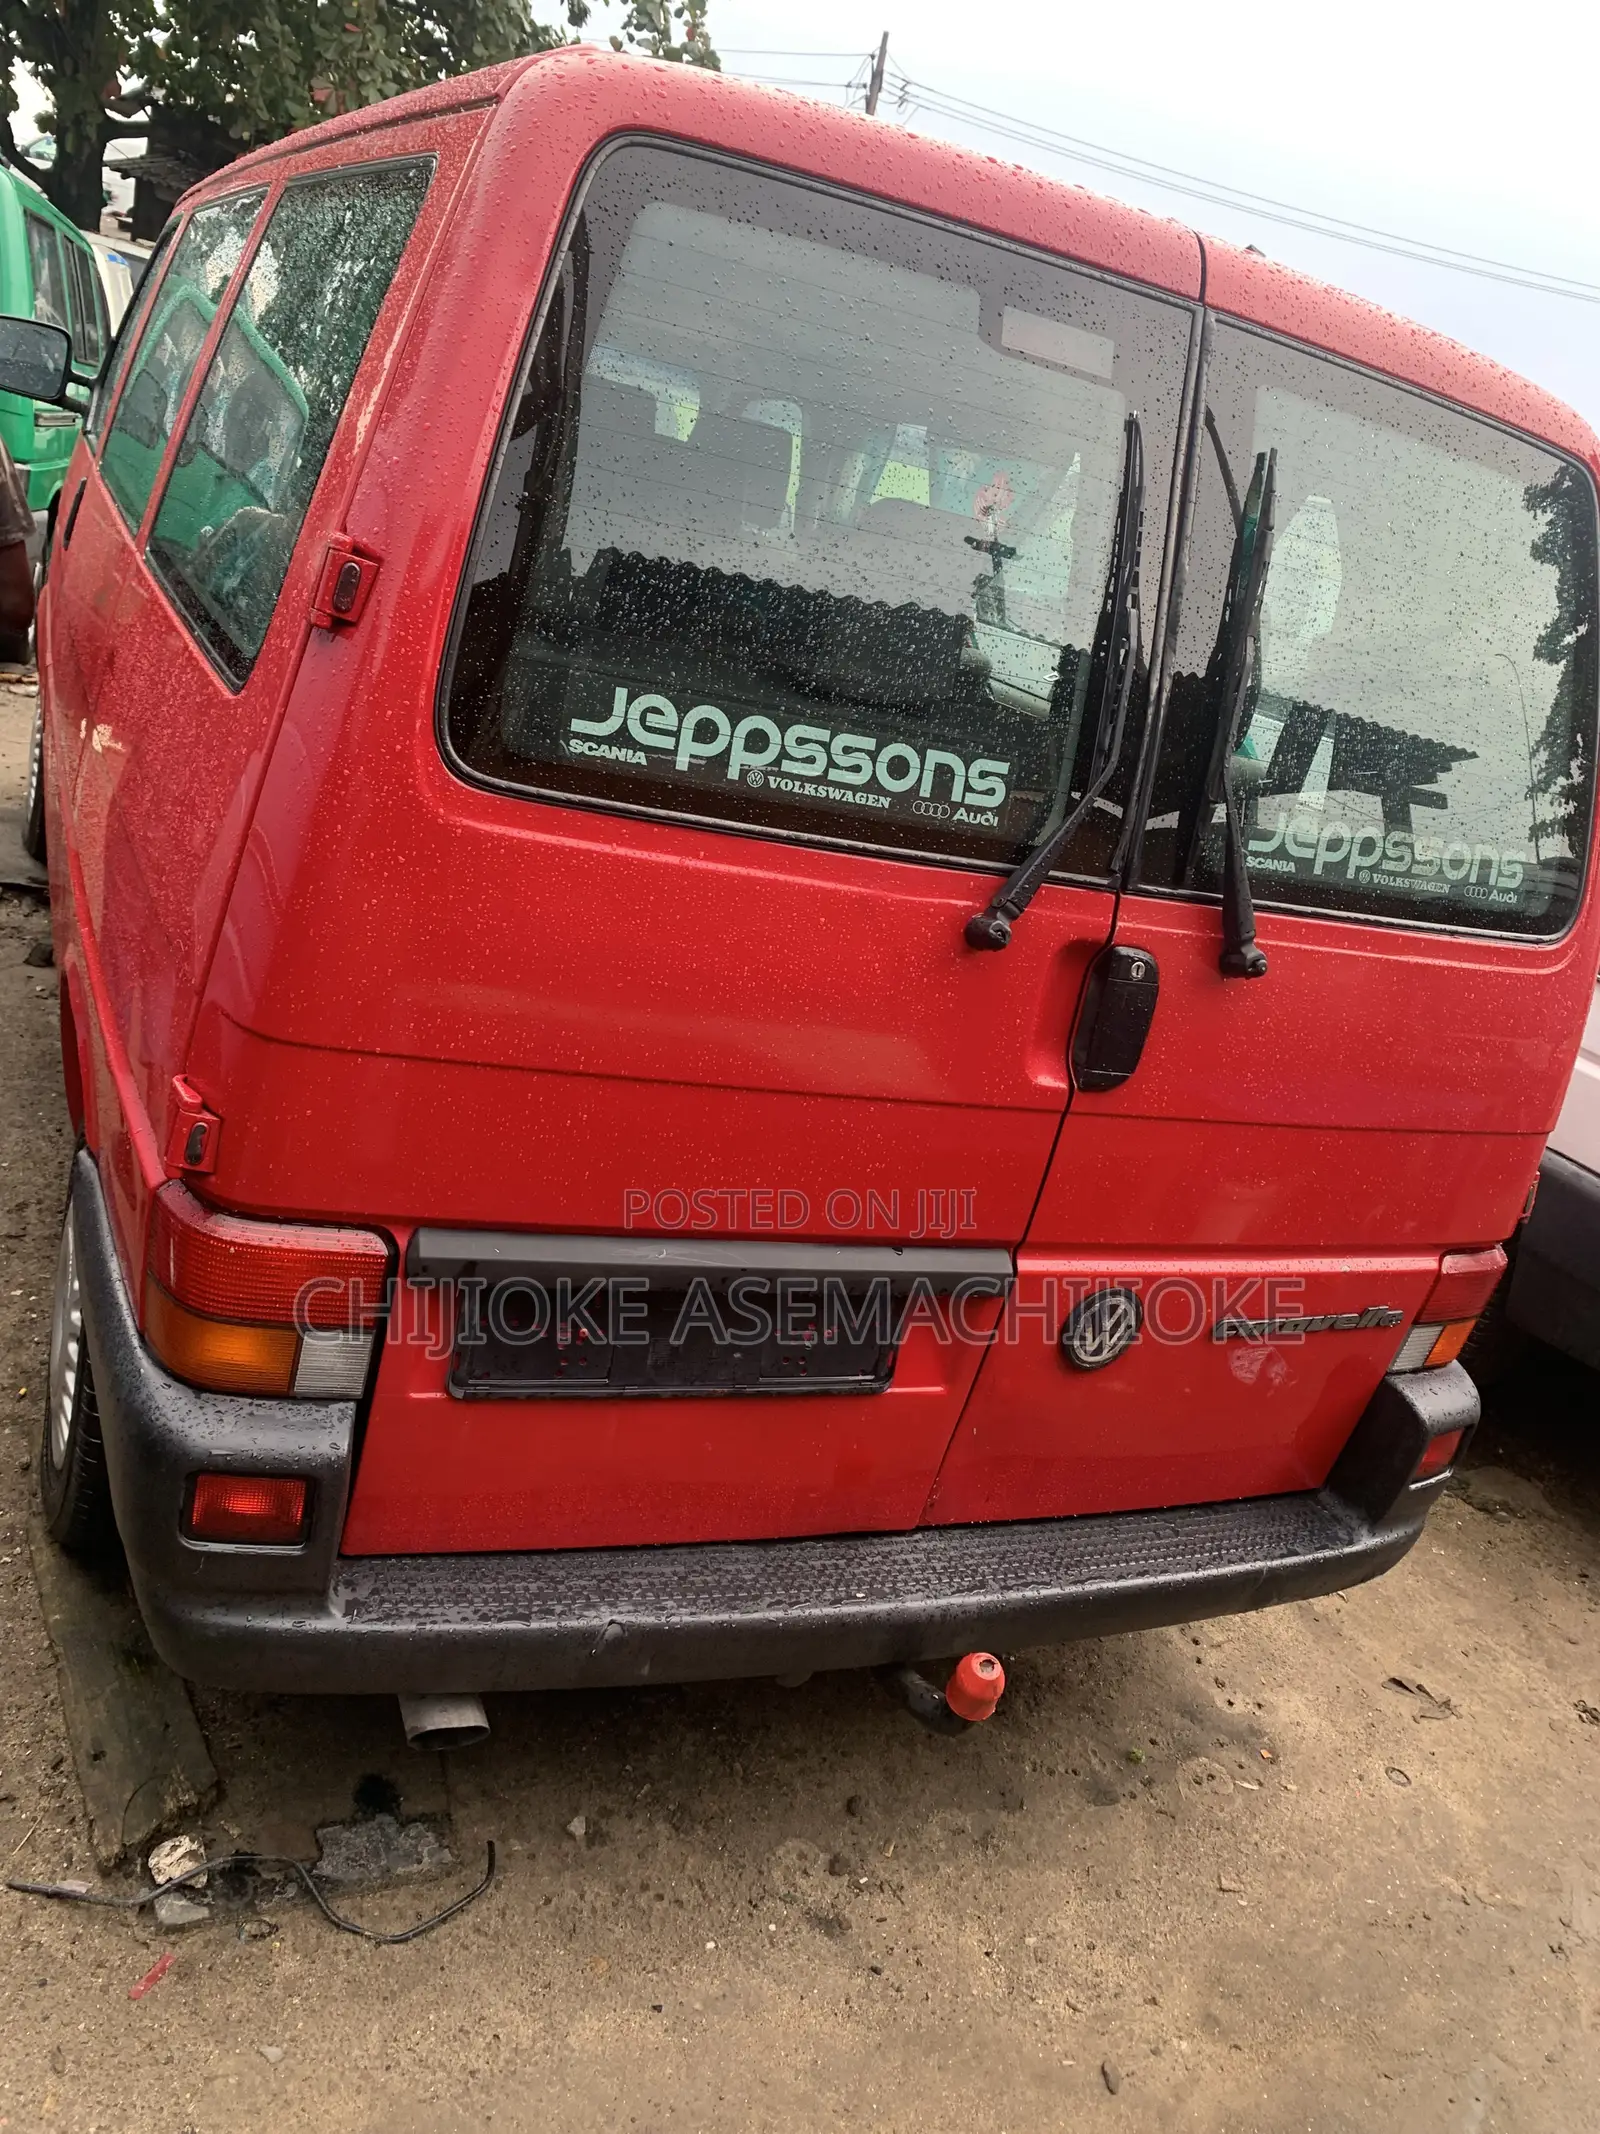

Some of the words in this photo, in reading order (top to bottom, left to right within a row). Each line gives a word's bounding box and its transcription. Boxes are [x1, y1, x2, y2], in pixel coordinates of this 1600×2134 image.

[568, 739, 647, 766] SCANIA
[570, 687, 1010, 807] Jeppssons
[767, 775, 892, 809] VOLKSWAGEN
[953, 807, 999, 827] Audi
[1247, 813, 1527, 889] Jeppssons
[1245, 855, 1296, 873] SCANIA
[1372, 873, 1450, 894] VOLKSWAGEN
[1488, 889, 1518, 904] Audi
